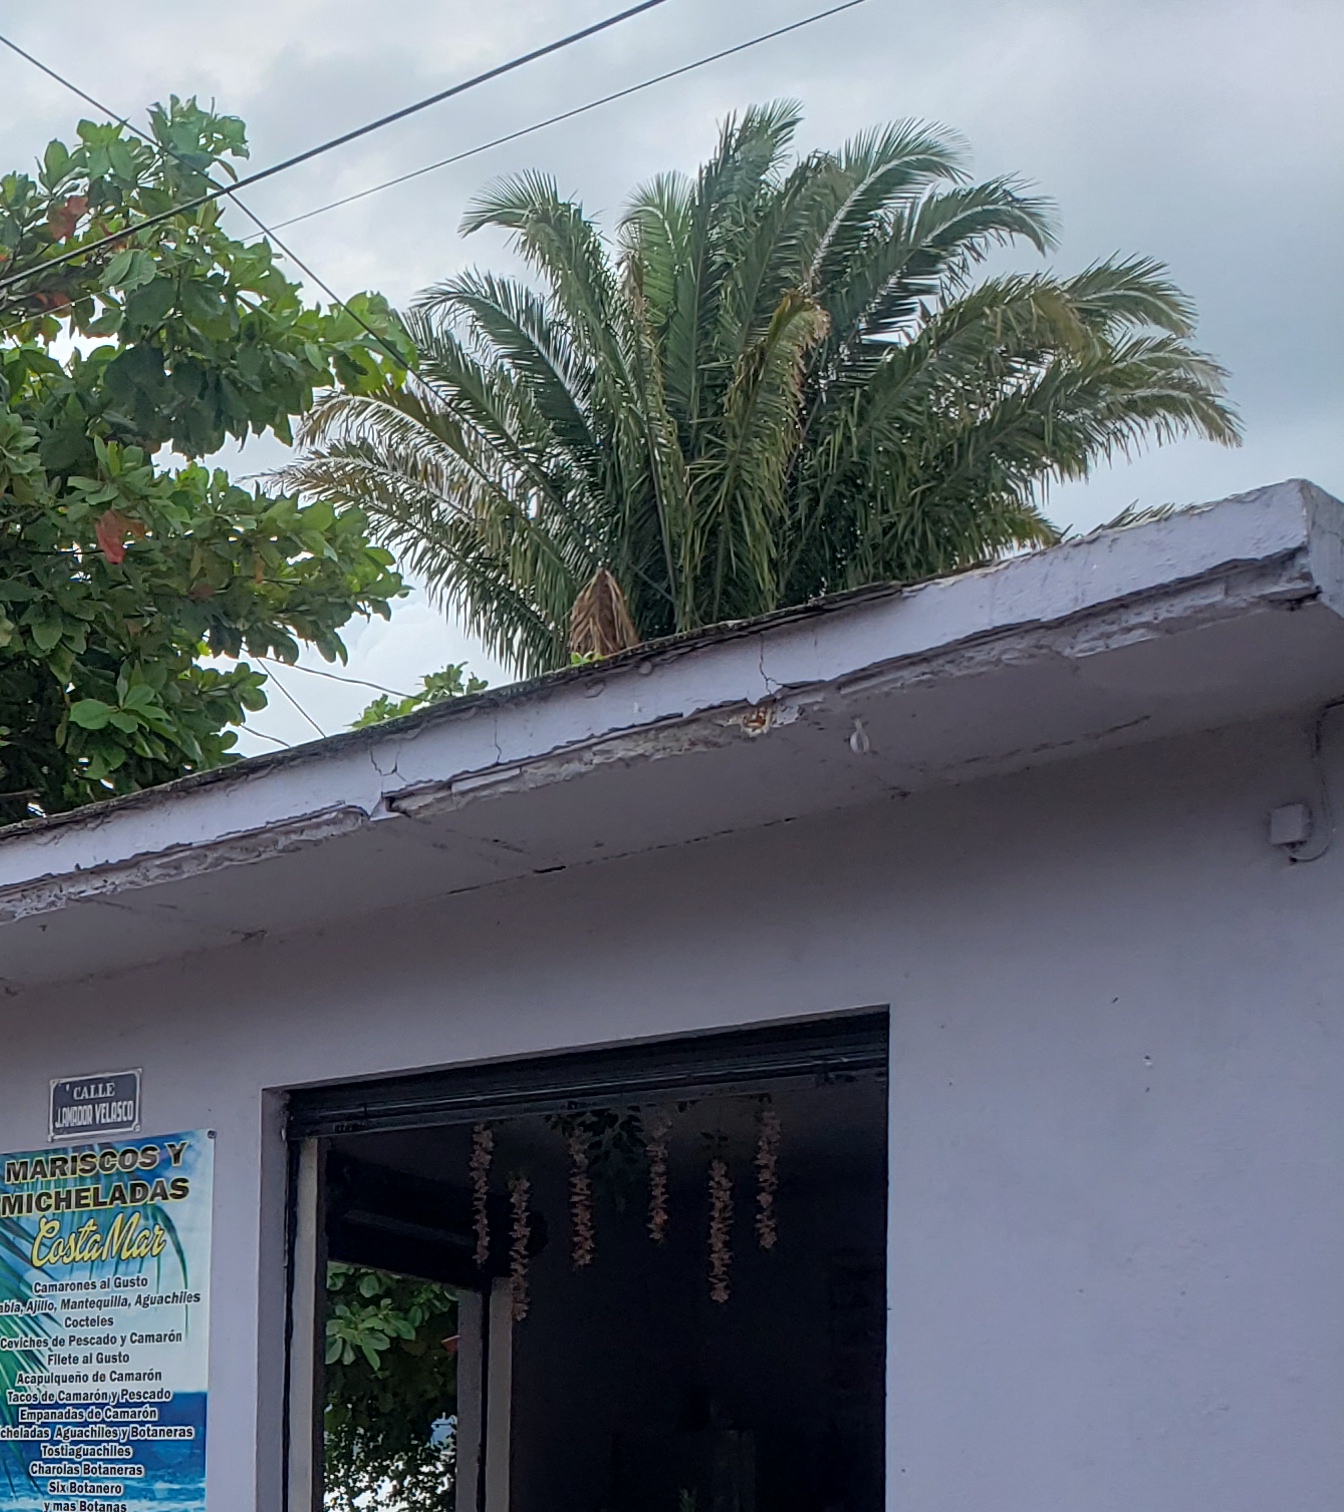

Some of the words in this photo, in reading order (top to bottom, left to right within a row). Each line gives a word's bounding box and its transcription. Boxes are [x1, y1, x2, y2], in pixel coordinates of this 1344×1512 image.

[73, 1083, 115, 1100] CALLE
[95, 1100, 133, 1125] VELASCO
[5, 1146, 160, 1183] MARISCOS
[164, 1141, 188, 1167] Y
[0, 1177, 190, 1218] MICHELADAS
[33, 1280, 97, 1294] Camarones
[100, 1278, 110, 1289] al
[113, 1276, 149, 1289] Gusto
[26, 1300, 57, 1313] Ajillo,
[60, 1294, 132, 1311] Mantequilla,
[134, 1291, 201, 1308] Aguachiles
[64, 1315, 114, 1328] Cocteles
[0, 1336, 48, 1350] Ceviches
[52, 1335, 65, 1347] de
[68, 1332, 117, 1347] Pescado
[120, 1334, 127, 1347] y
[130, 1329, 182, 1344] Camarón
[47, 1353, 79, 1366] Filete
[82, 1352, 92, 1364] al
[96, 1351, 130, 1364] Gusto
[16, 1370, 89, 1386] Acapulqueño
[92, 1370, 106, 1382] de
[109, 1368, 162, 1382] Camarón
[7, 1391, 38, 1403] Tacos
[41, 1390, 55, 1402] de
[58, 1388, 108, 1402] Camarón
[111, 1391, 118, 1404] y
[121, 1387, 171, 1400] Pescado
[20, 1408, 84, 1423] Empanadas
[87, 1407, 101, 1419] de
[104, 1404, 157, 1420] Camarón
[55, 1426, 118, 1441] Aguachiles
[120, 1429, 129, 1441] y
[131, 1426, 194, 1438] Botaneras
[41, 1444, 132, 1459] Tostiaguachiles
[30, 1463, 80, 1475] Charolas
[83, 1463, 143, 1476] Botaneras
[48, 1482, 66, 1494] Six
[69, 1482, 123, 1495] Botanero
[52, 1502, 76, 1512] mas
[79, 1501, 127, 1512] Botanas
